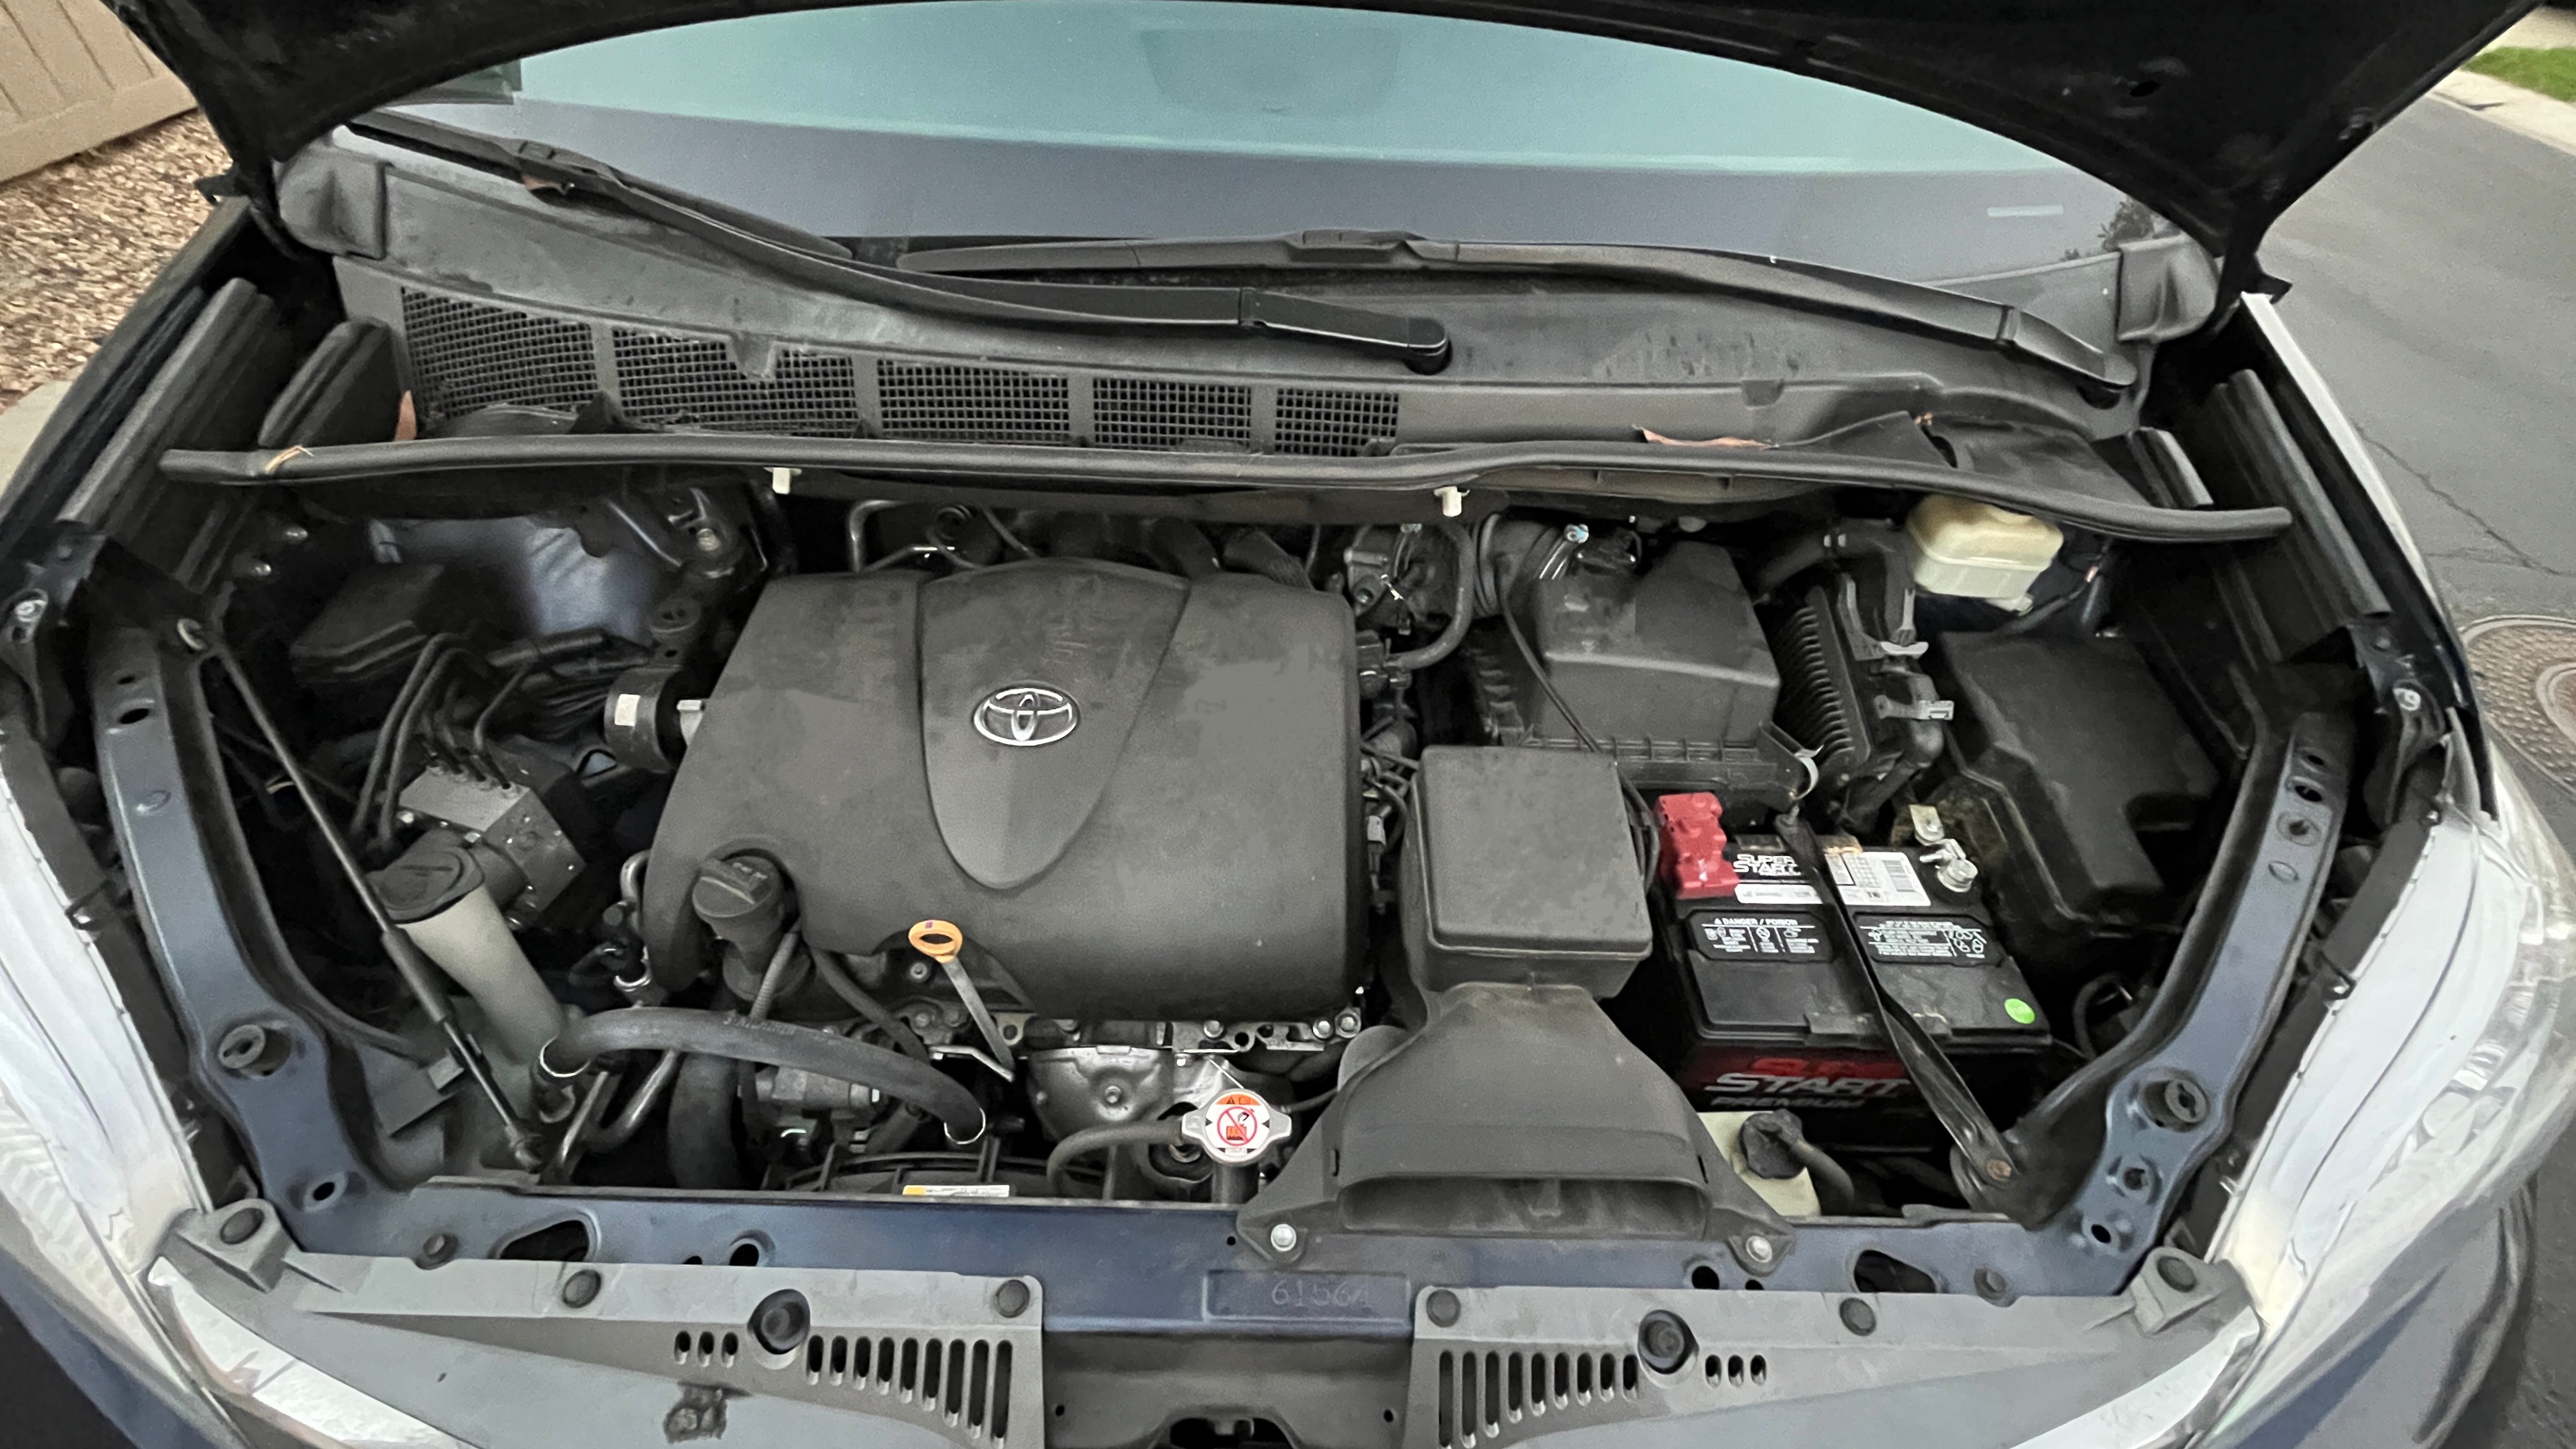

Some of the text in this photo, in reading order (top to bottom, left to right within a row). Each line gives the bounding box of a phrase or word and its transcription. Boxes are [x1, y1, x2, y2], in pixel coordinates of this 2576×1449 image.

[1736, 854, 1797, 866] SUPER
[1733, 861, 1799, 873] START
[1704, 1072, 1912, 1096] START
